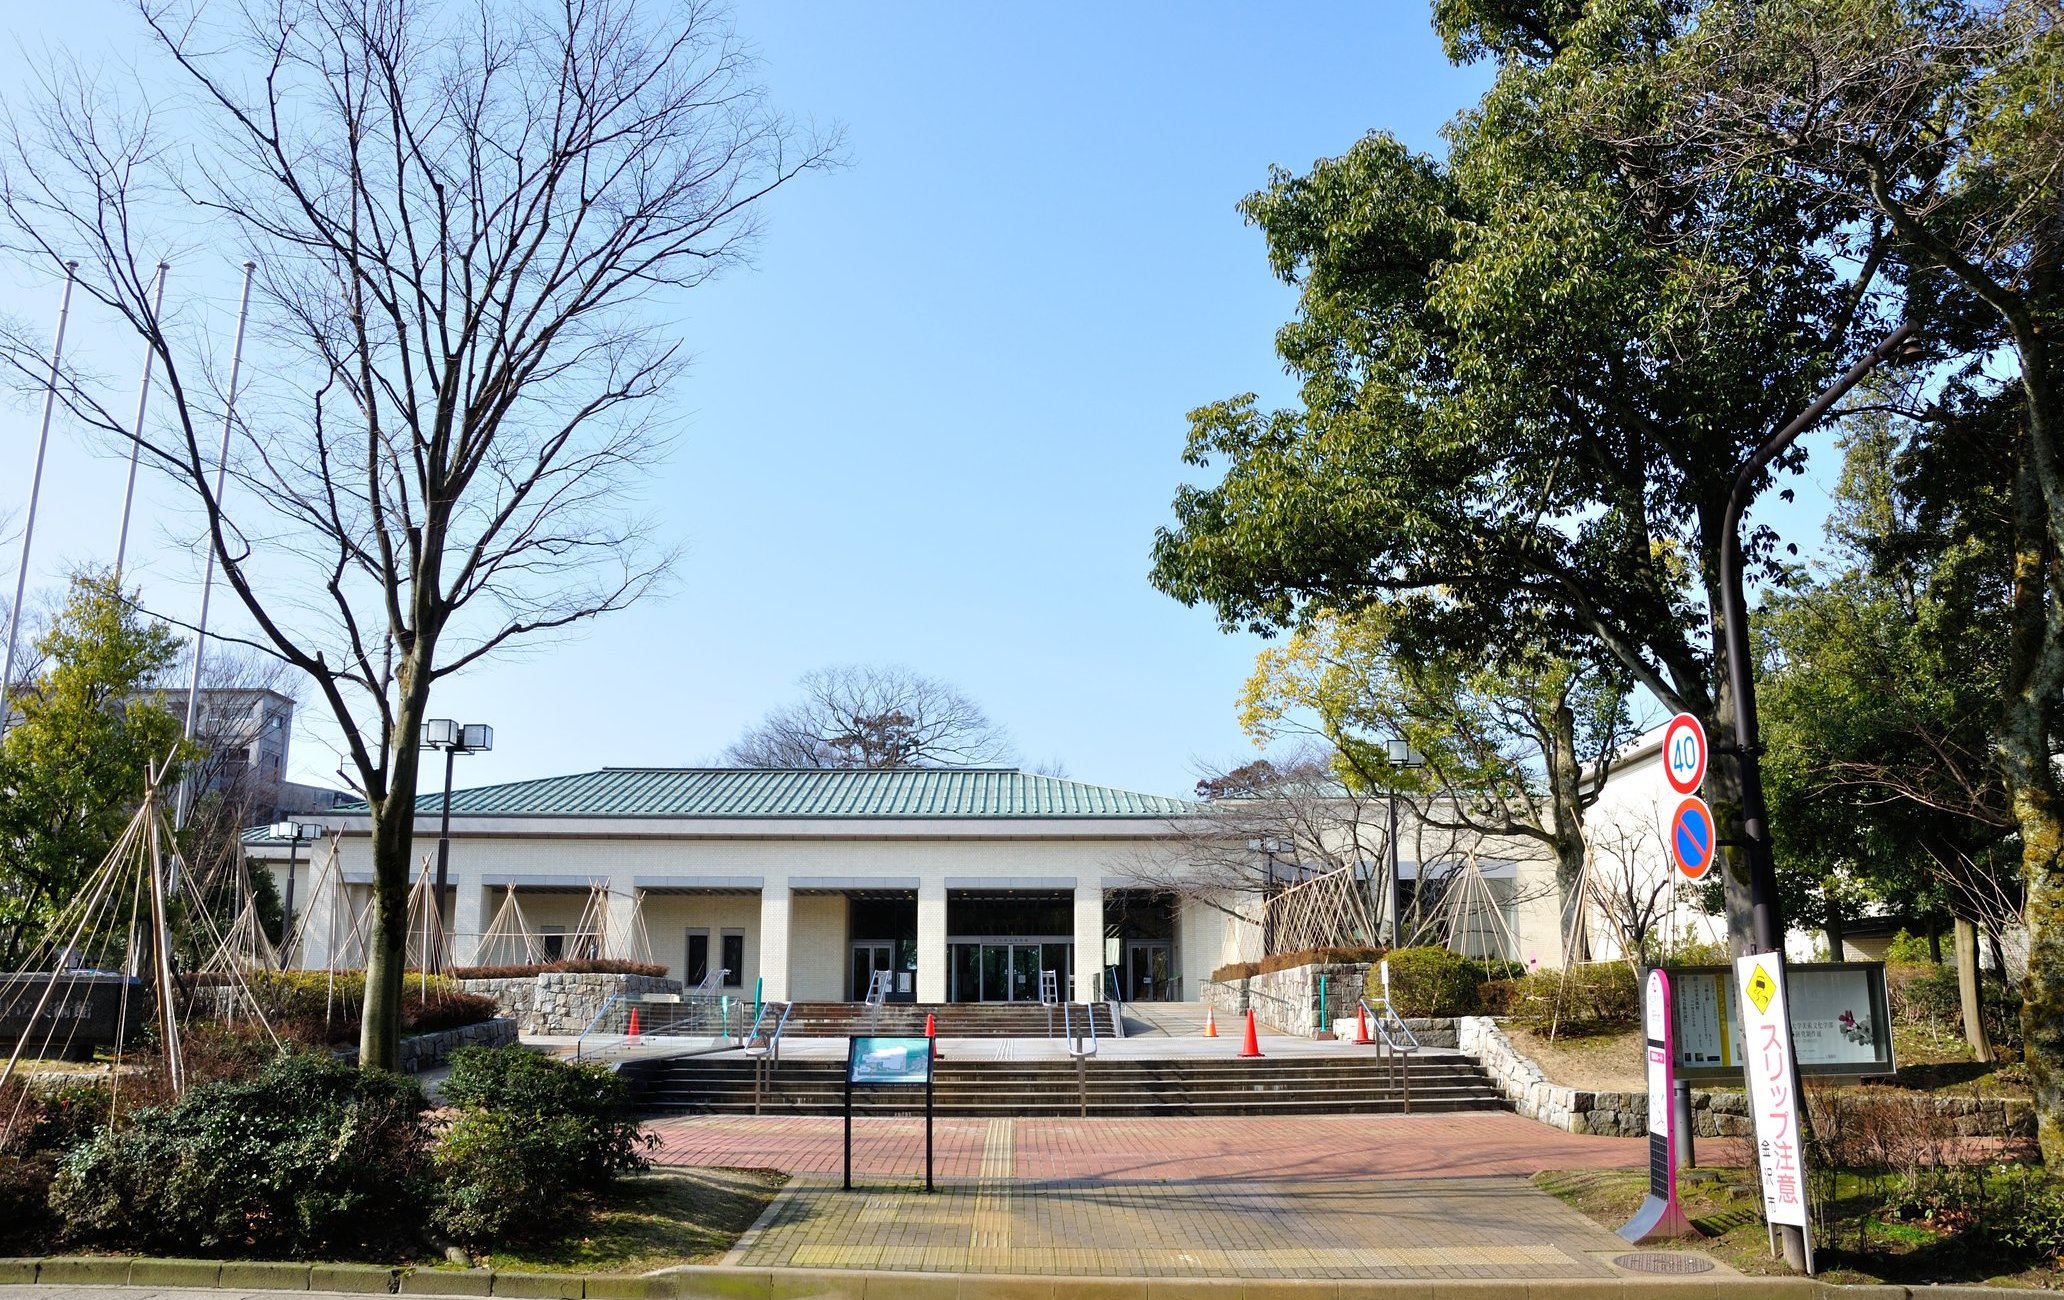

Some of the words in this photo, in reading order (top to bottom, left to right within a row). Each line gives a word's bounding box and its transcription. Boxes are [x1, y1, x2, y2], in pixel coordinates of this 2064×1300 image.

[1673, 735, 1696, 773] 40
[1761, 1024, 1798, 1205] スリップ注意
[1761, 1139, 1777, 1214] 金沢市
